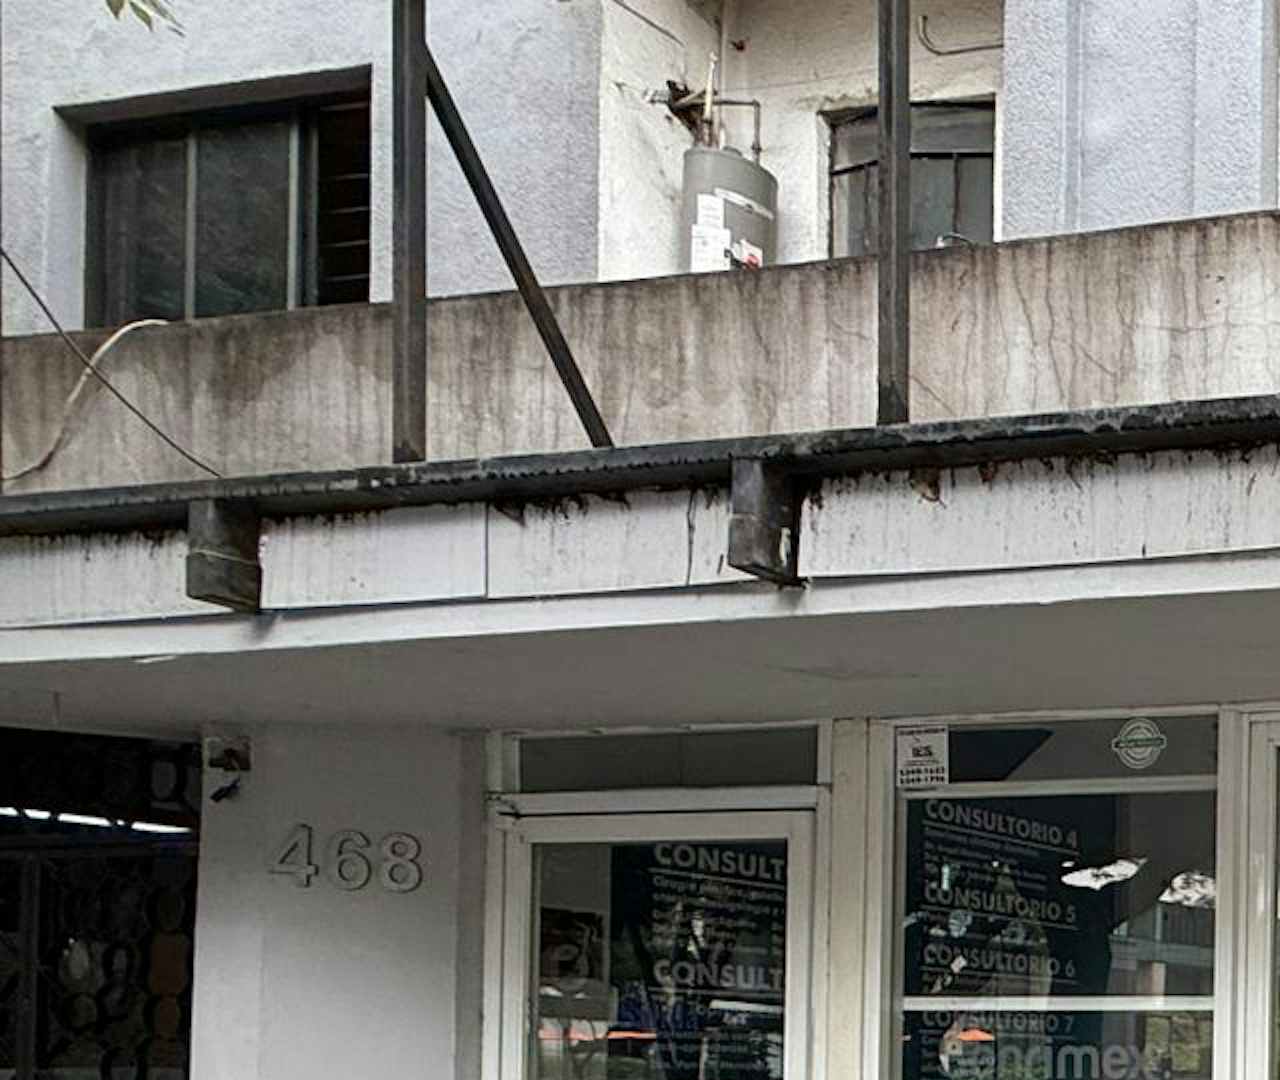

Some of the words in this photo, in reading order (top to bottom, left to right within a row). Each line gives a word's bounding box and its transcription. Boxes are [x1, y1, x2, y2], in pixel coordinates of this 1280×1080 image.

[925, 799, 1063, 845] CONSULTORIO
[1066, 831, 1078, 849] 4
[267, 823, 424, 894] 468
[924, 882, 1062, 920] CONSULTORIO
[1065, 905, 1077, 923] 5
[1065, 959, 1076, 977] 6
